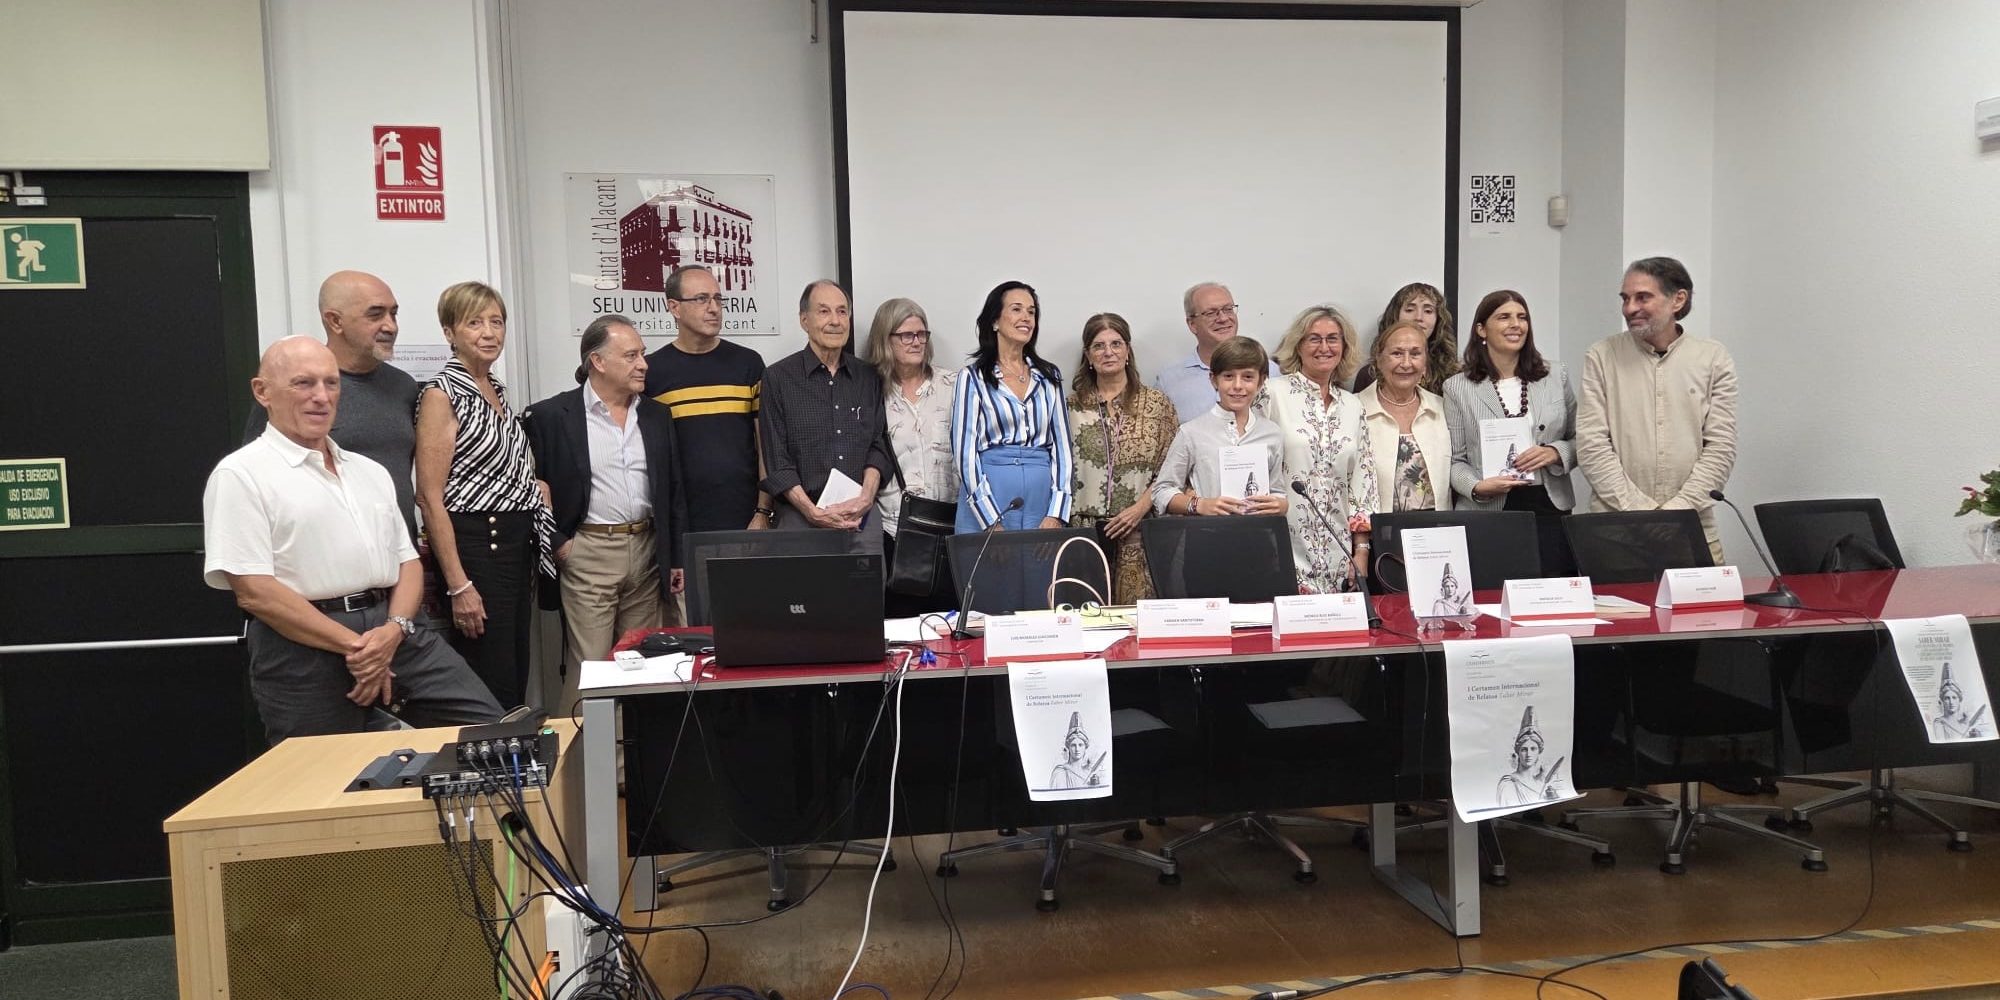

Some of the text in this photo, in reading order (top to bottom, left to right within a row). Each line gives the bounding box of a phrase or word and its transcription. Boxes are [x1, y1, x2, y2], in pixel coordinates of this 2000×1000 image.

[380, 198, 442, 214] EXTINTOR
[591, 178, 620, 290] Ciutat d'Alacant
[592, 297, 624, 314] SEU
[16, 469, 25, 482] DE
[25, 468, 59, 482] EMERGENCIA
[9, 487, 50, 502] USO EXCLUSIVO
[7, 508, 21, 521] PARA
[1501, 682, 1540, 690] Internacional
